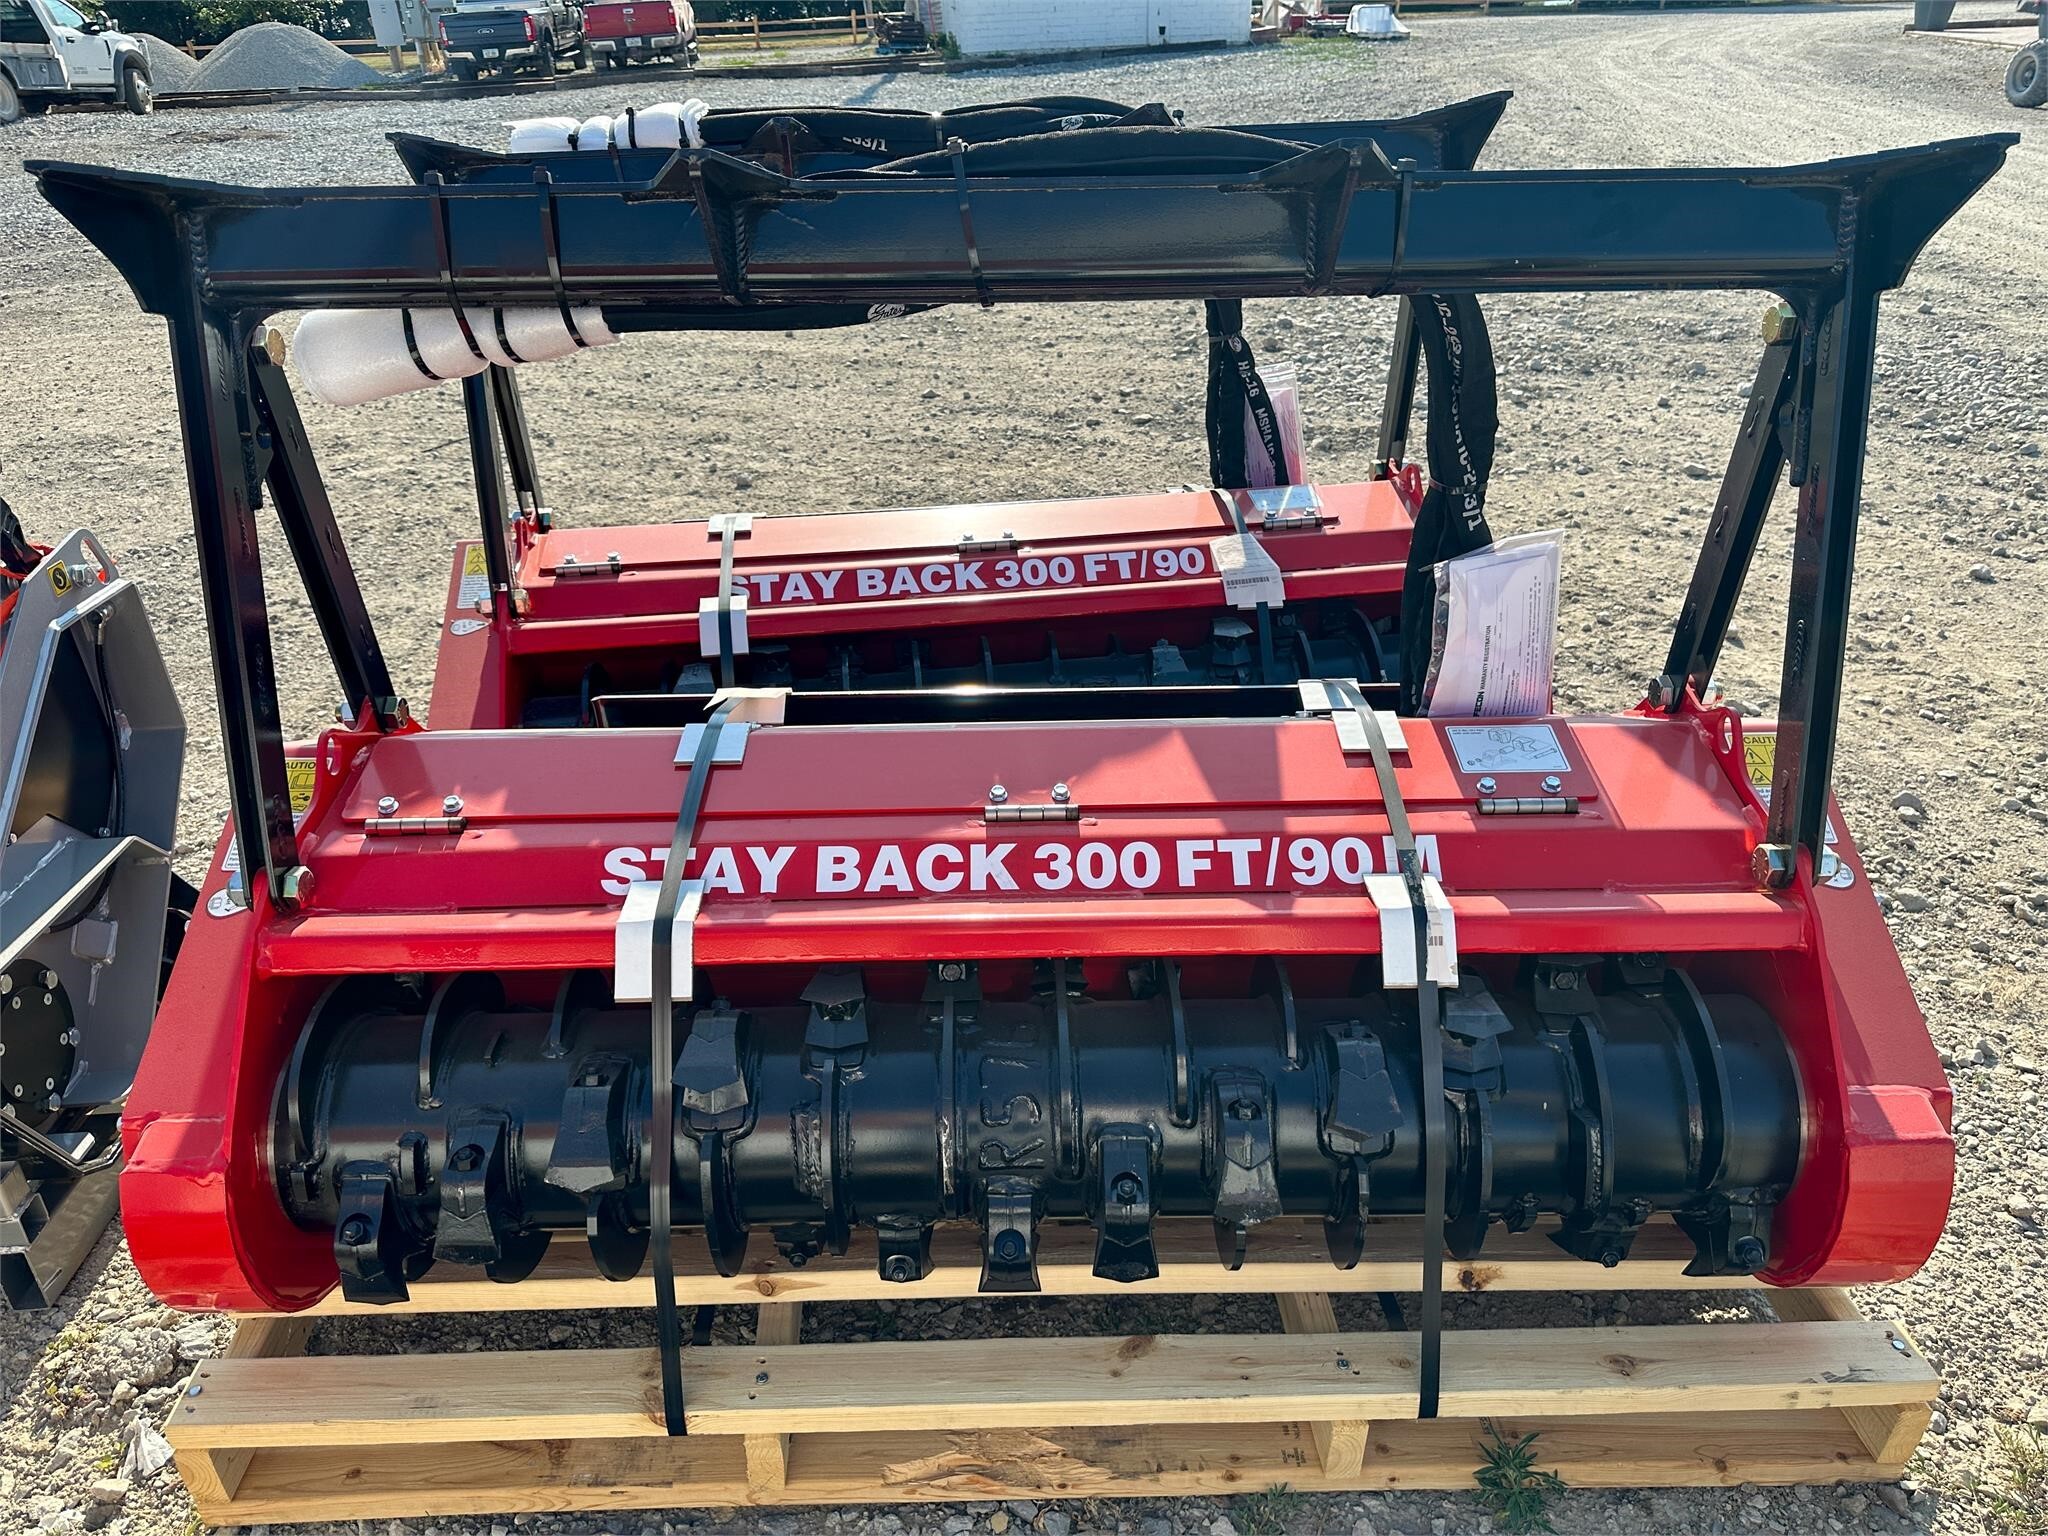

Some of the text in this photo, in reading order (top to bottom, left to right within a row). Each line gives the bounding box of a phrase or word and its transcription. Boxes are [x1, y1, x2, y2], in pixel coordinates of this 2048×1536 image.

[868, 303, 905, 323] Gates
[857, 561, 989, 598] BACK
[994, 556, 1076, 589] 300
[1082, 546, 1206, 583] FT/90
[1483, 625, 1492, 662] REGISTRATION
[1480, 662, 1489, 691] WARRANTY
[285, 761, 317, 770] AUTIO
[815, 843, 1021, 893] BACK
[1033, 841, 1162, 891] 300
[1176, 836, 1374, 888] FT/90
